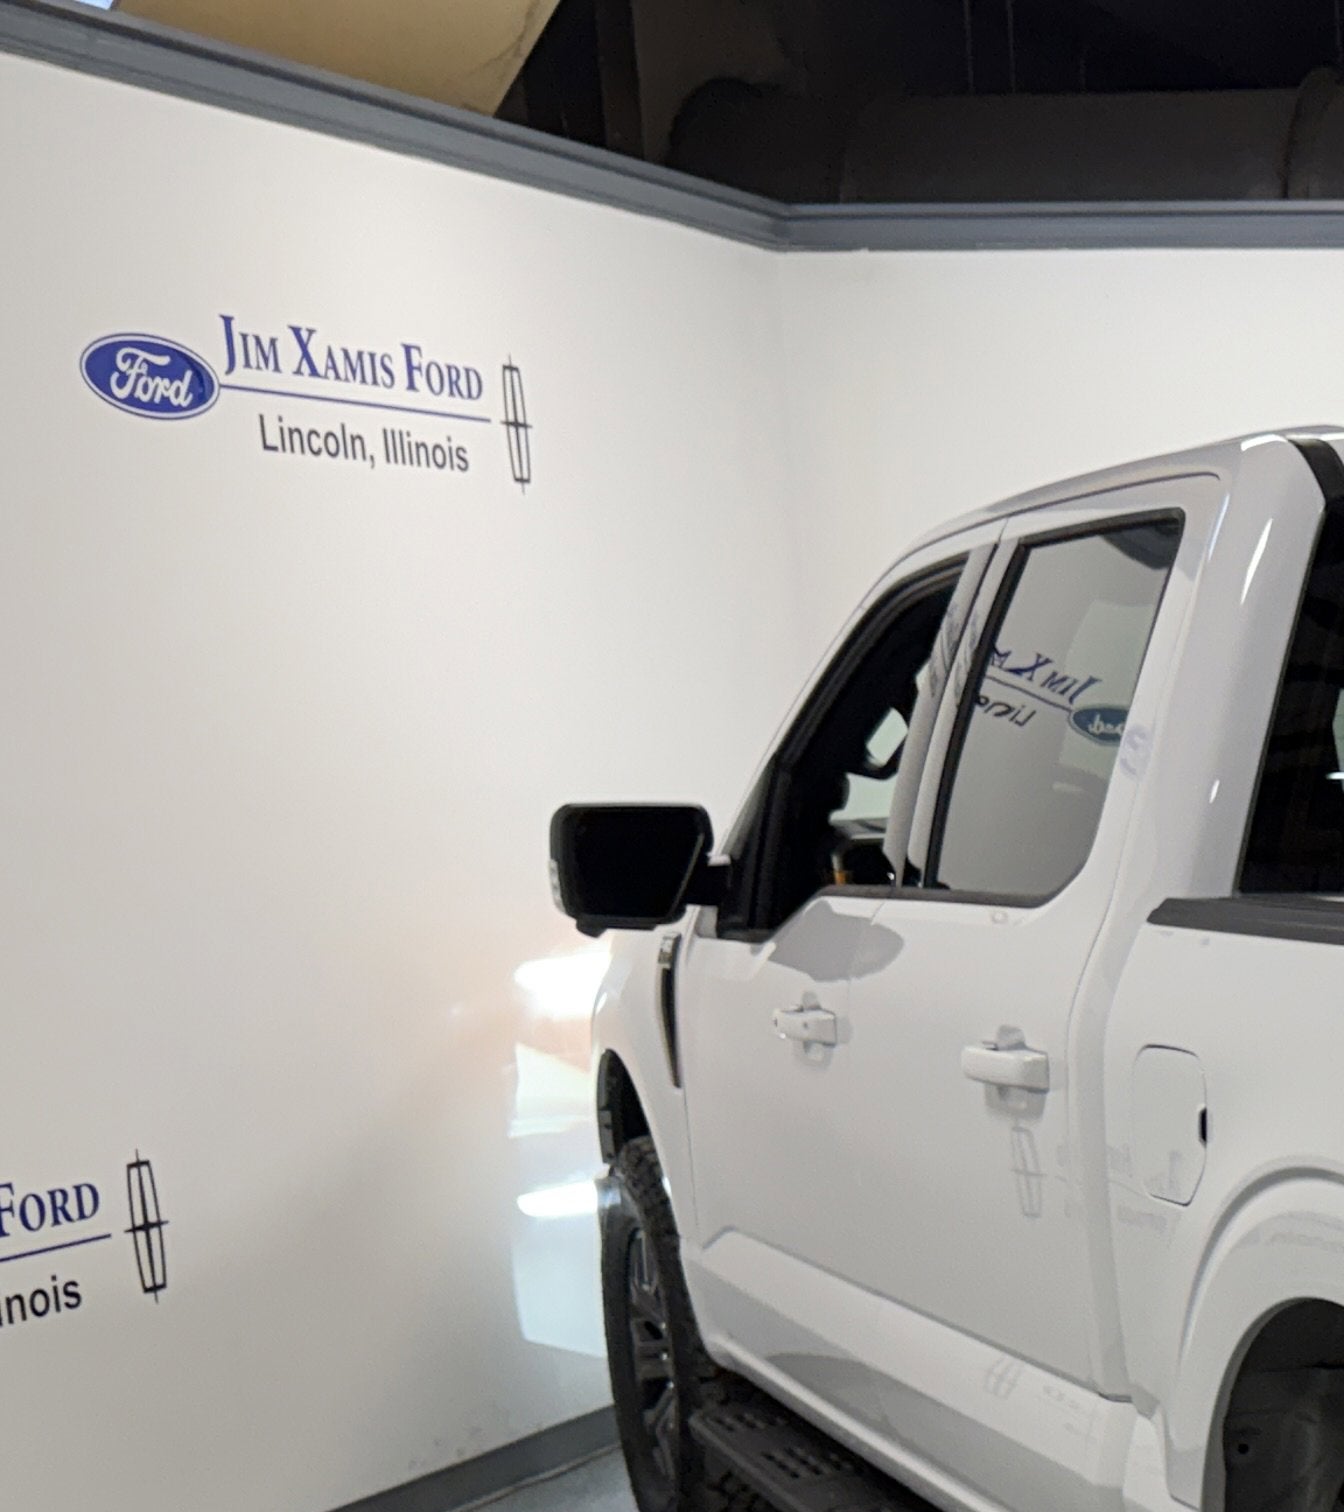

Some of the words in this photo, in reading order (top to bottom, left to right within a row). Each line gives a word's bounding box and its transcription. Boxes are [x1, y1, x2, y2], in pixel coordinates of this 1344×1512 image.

[110, 347, 193, 407] Ford
[219, 314, 281, 376] JIM
[288, 325, 395, 389] XAMIS
[401, 343, 482, 401] FORD
[259, 414, 374, 468] Lincoln,
[383, 428, 469, 473] Illinois
[0, 1182, 99, 1238] FORD
